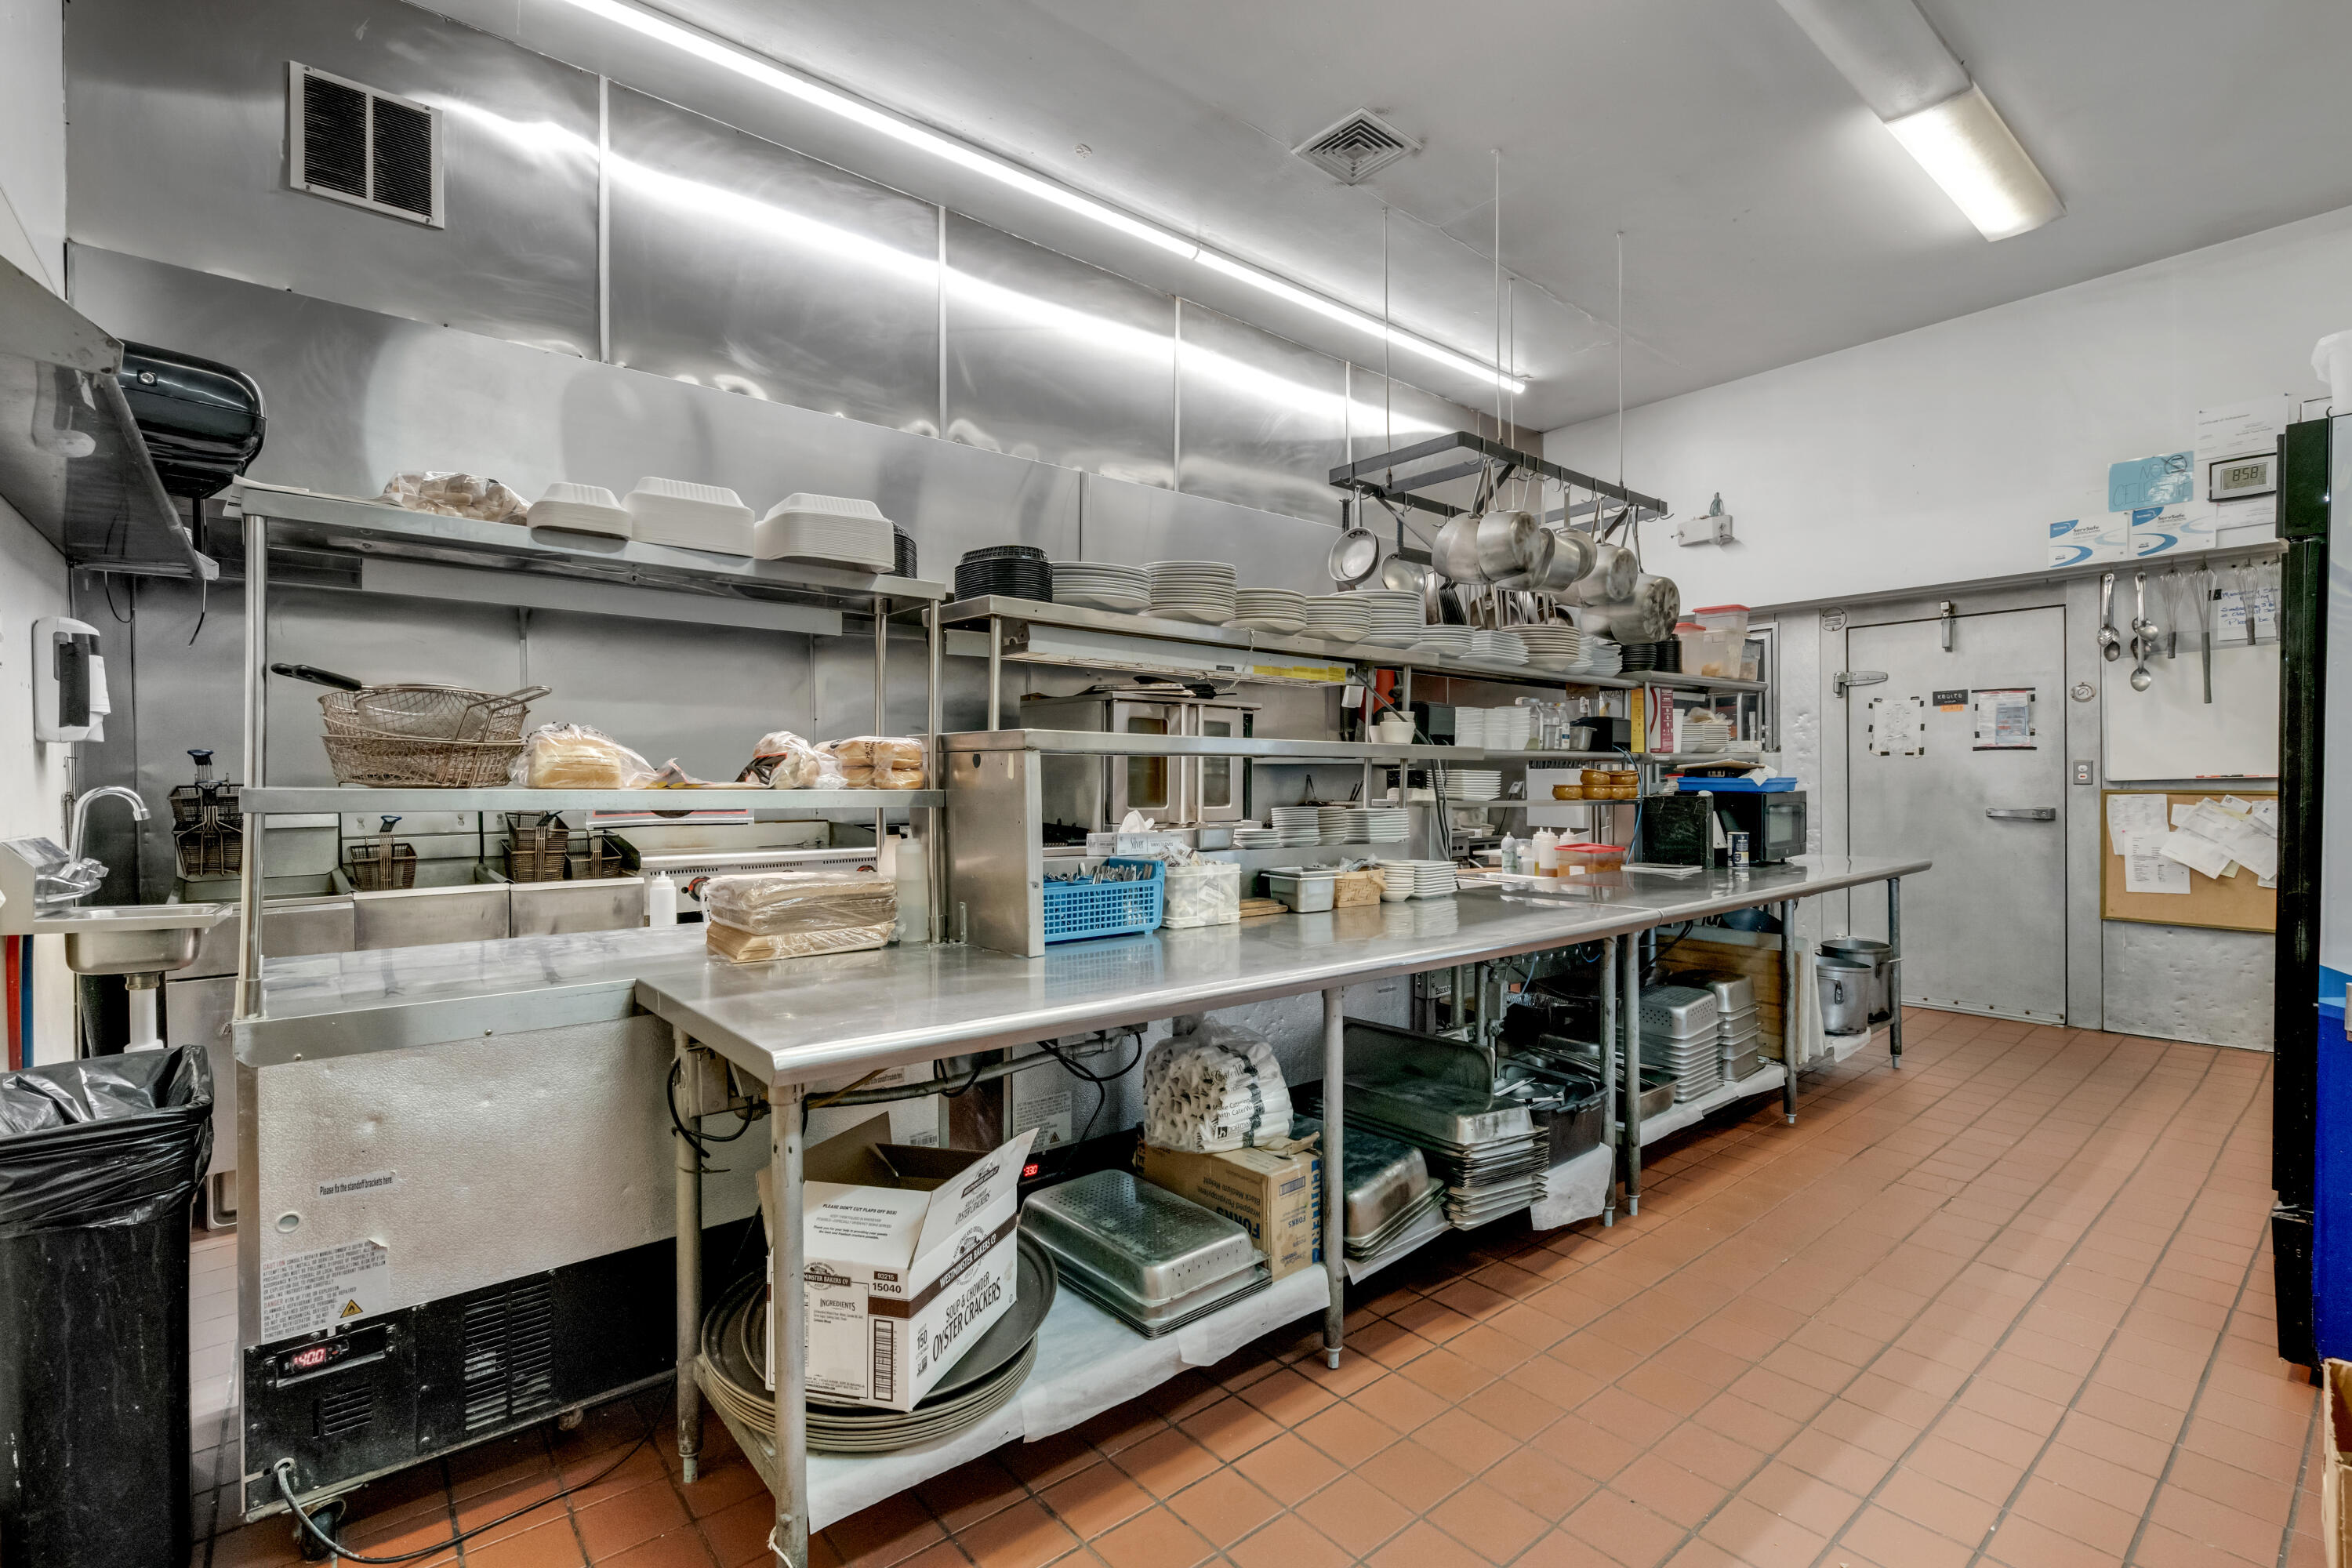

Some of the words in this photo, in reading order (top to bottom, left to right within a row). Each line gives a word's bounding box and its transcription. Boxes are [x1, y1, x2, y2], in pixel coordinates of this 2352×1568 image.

[2073, 524, 2100, 533] ServSafe
[1599, 690, 1622, 699] ANZIA
[1130, 837, 1145, 849] Silver
[319, 1185, 334, 1196] Please
[347, 1178, 365, 1191] standoff
[365, 1177, 383, 1189] brackets
[1203, 1176, 1221, 1190] Weight
[1221, 1185, 1244, 1200] Medium
[1245, 1192, 1261, 1206] Black
[1236, 1202, 1261, 1219] Wrapped
[1288, 1215, 1306, 1229] FORKS
[939, 1254, 973, 1288] WESTMINSTER
[973, 1239, 991, 1259] BAKERS
[804, 1272, 823, 1282] MINSTER
[823, 1276, 841, 1284] BAKERS
[873, 1283, 902, 1294] 15040
[946, 1298, 960, 1323] SOUP
[961, 1294, 966, 1308] &
[966, 1271, 990, 1302] CHOWDER
[820, 1298, 856, 1311] INGREDIENTS
[932, 1312, 963, 1362] OYSTER
[964, 1276, 1000, 1326] CRACKERS
[917, 1329, 927, 1350] 150
